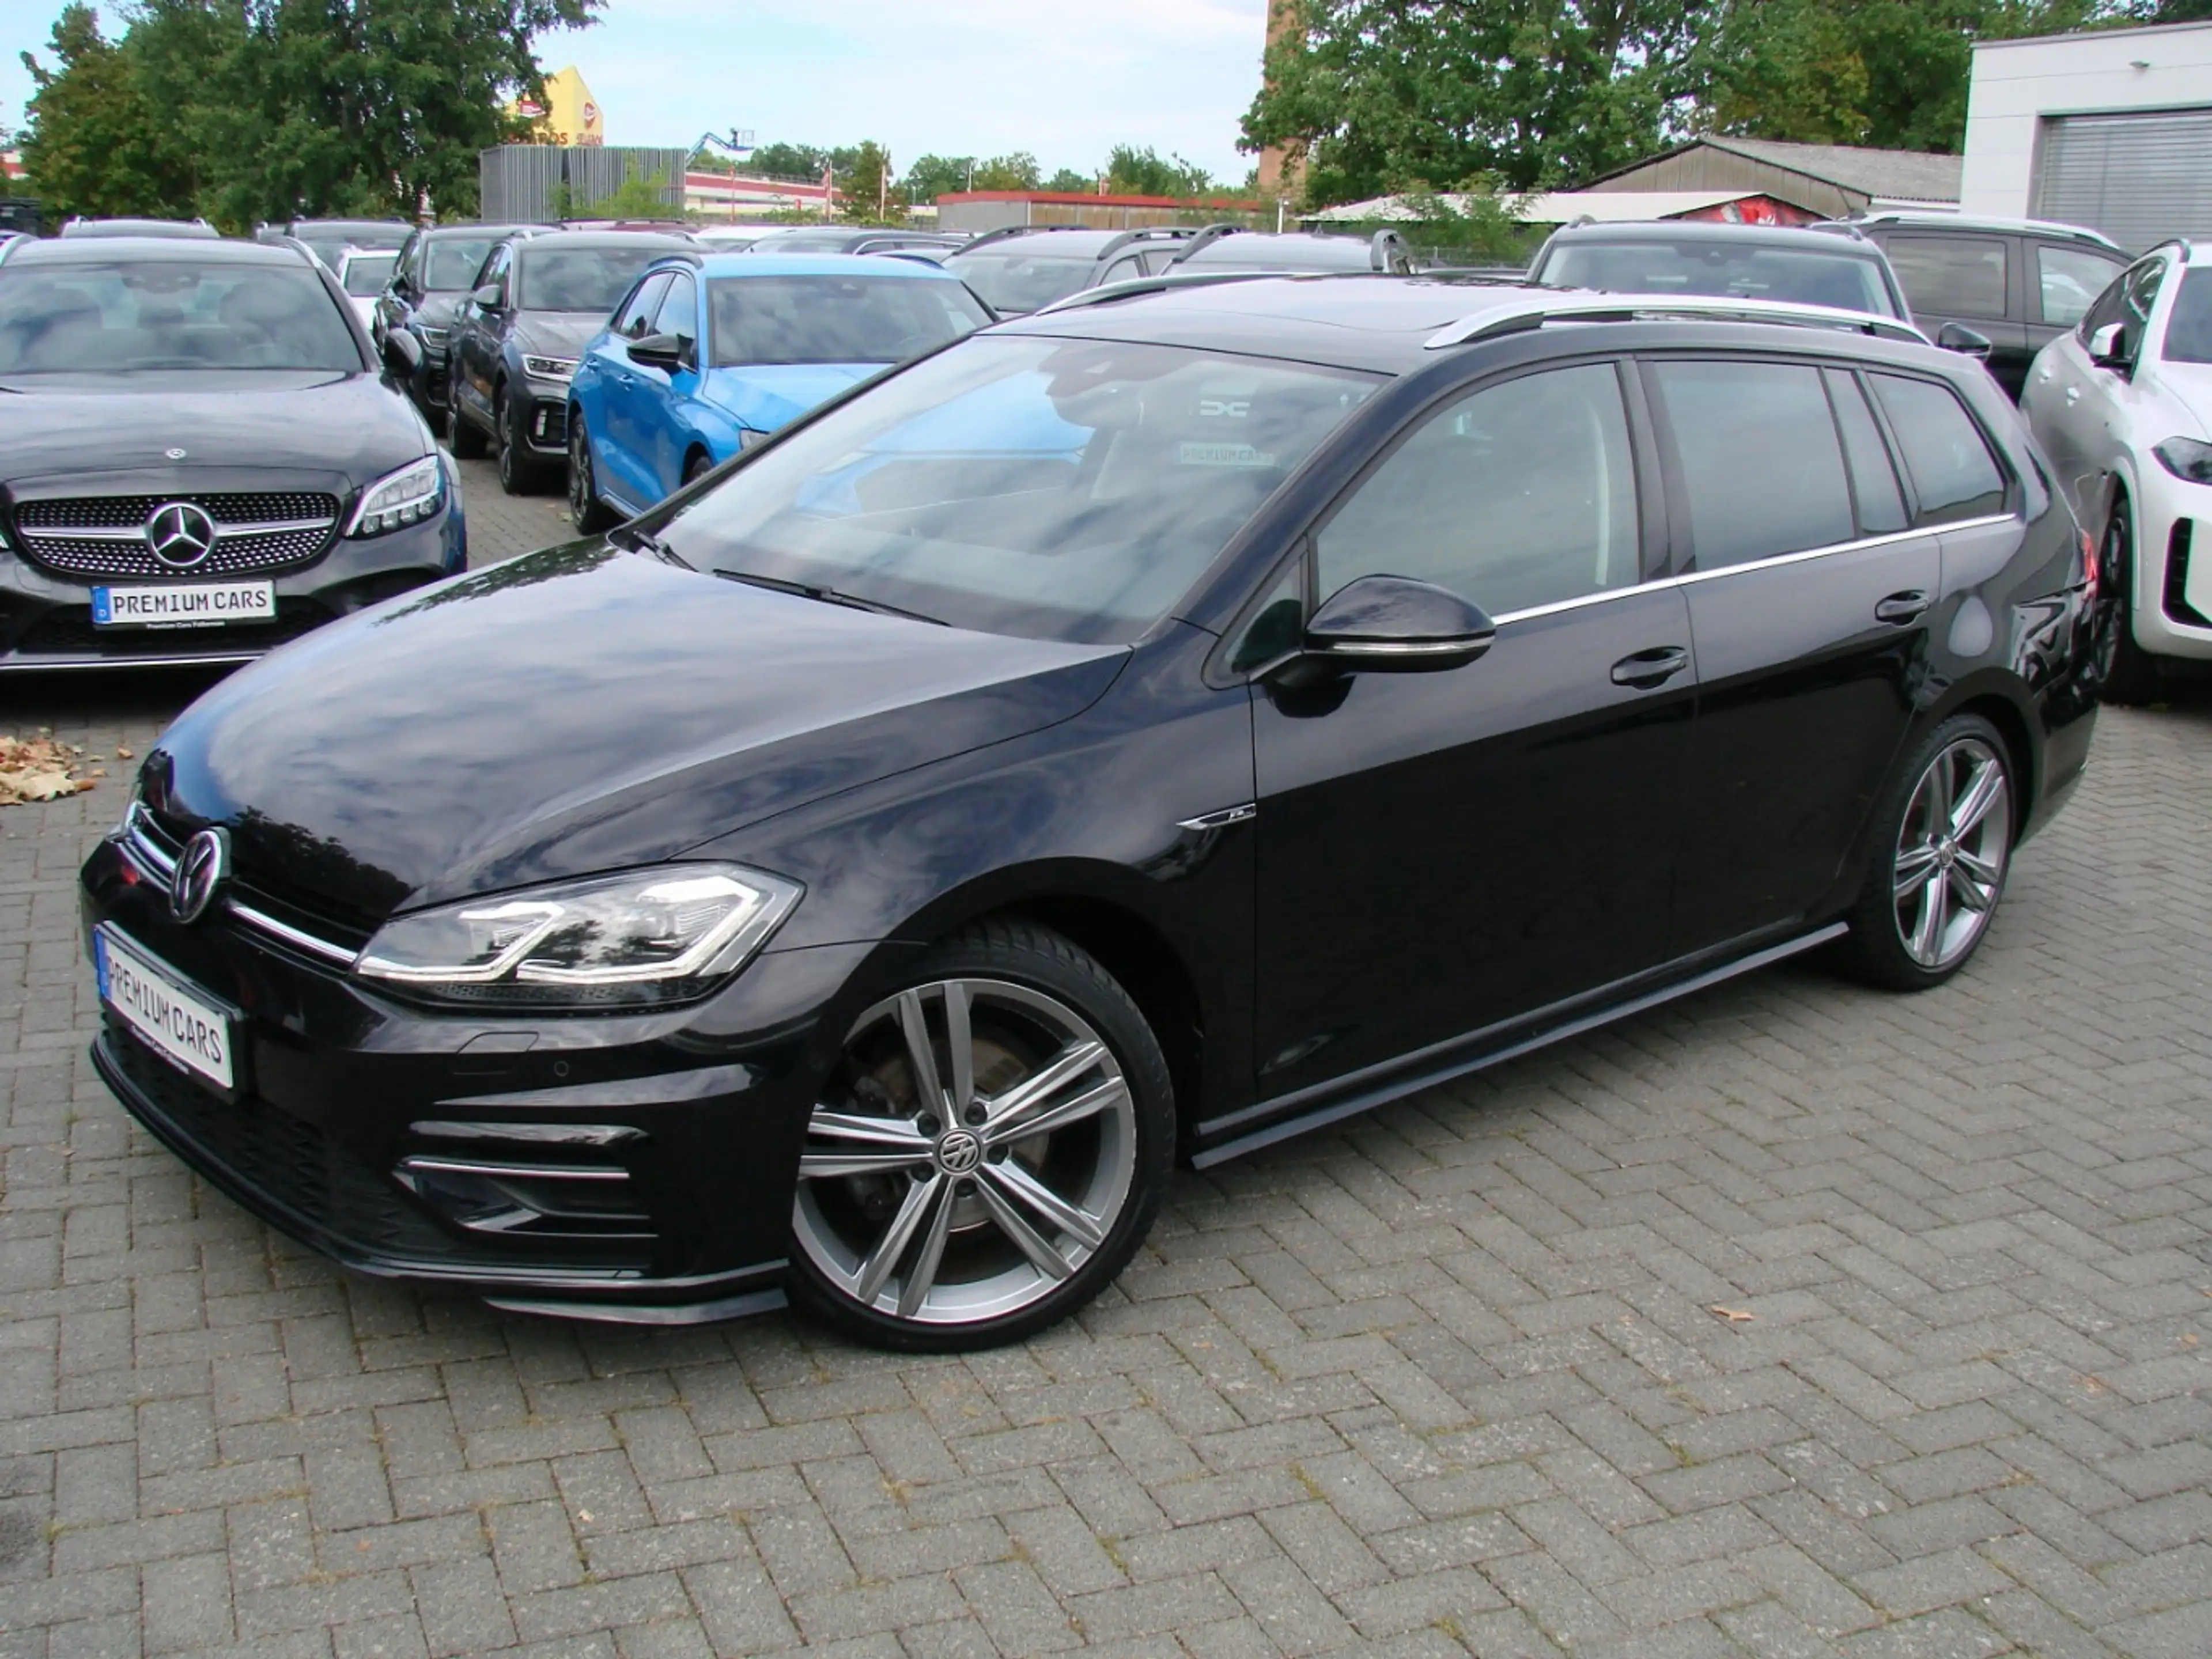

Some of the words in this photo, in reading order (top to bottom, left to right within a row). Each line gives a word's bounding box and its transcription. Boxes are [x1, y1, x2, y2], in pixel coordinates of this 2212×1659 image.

[113, 593, 209, 613] PREMIUM
[214, 589, 267, 609] CARS
[107, 956, 171, 1034] PREMIUM
[173, 1006, 222, 1064] CARS
